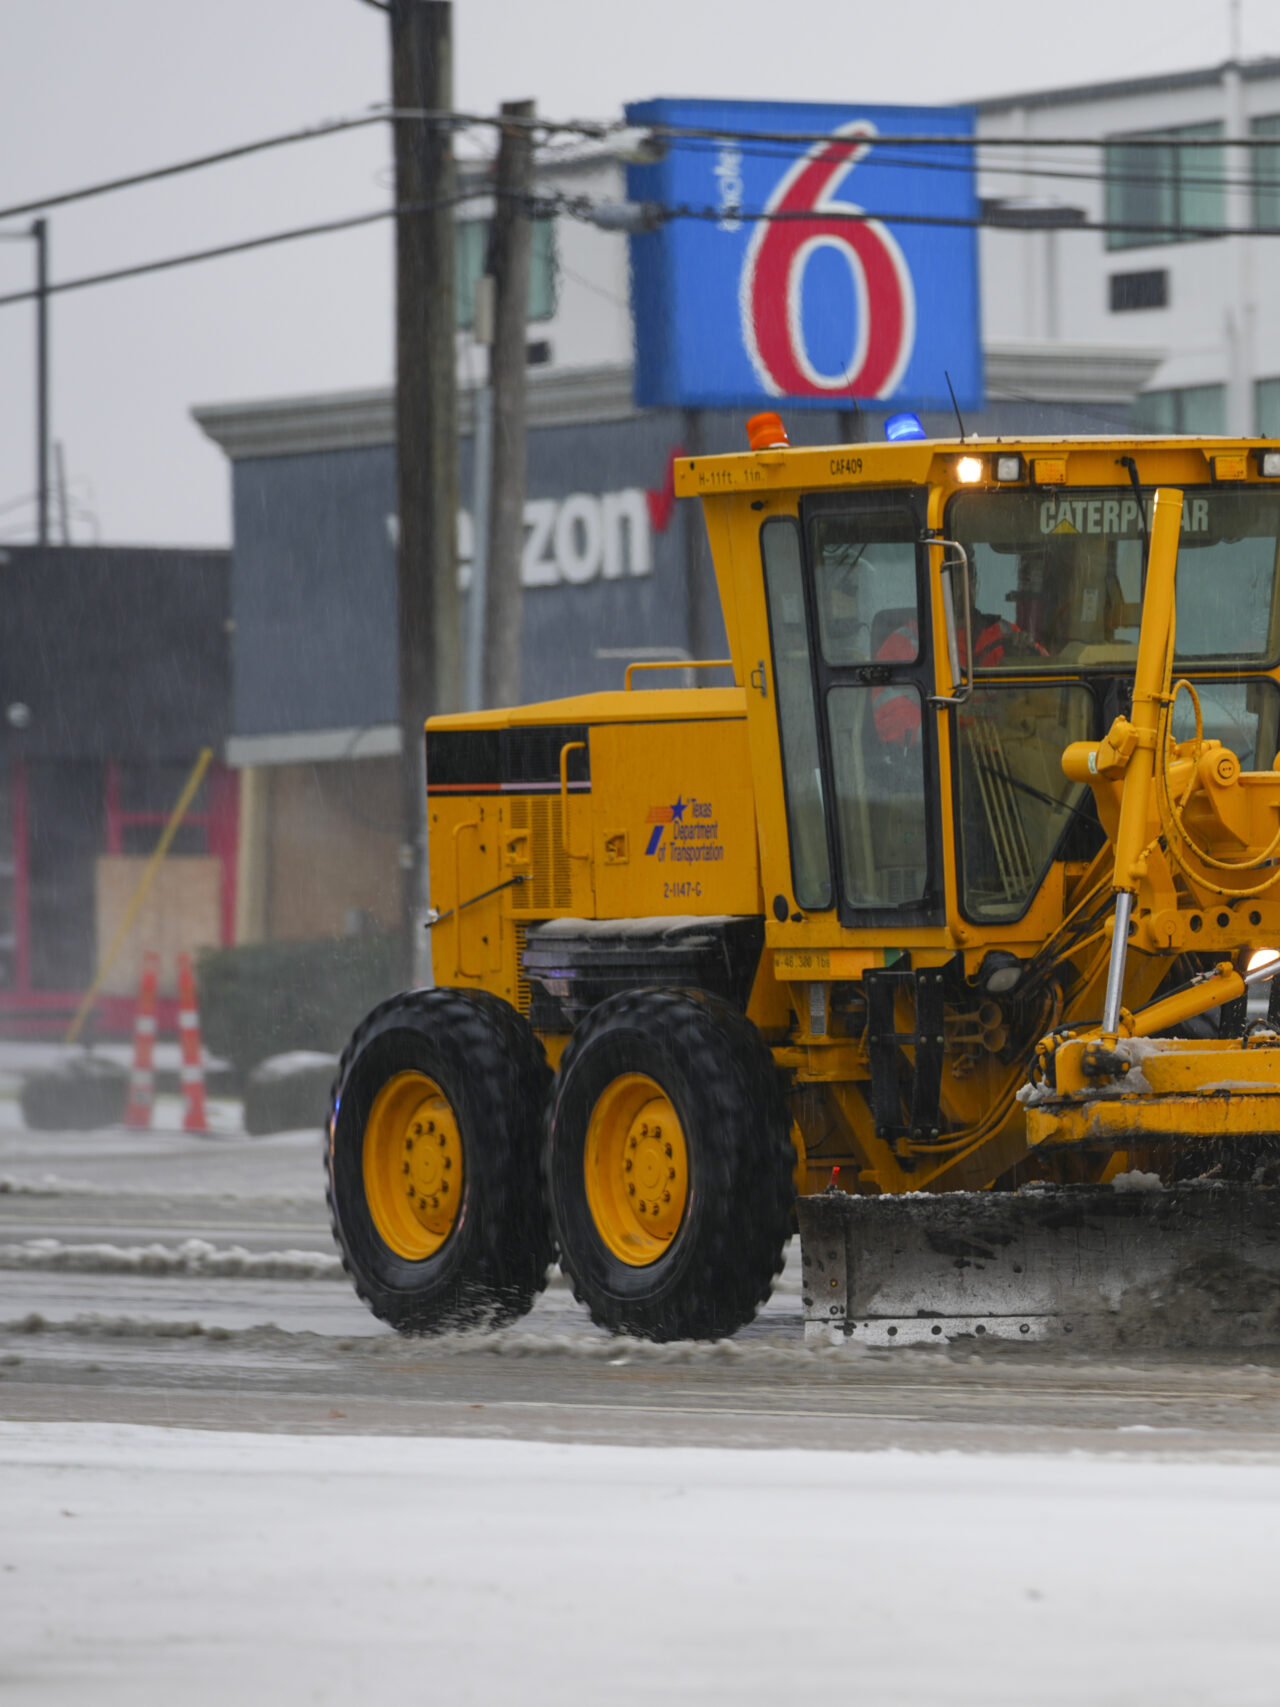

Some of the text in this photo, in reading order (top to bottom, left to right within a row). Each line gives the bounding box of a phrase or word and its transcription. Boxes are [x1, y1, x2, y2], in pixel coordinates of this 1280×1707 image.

[739, 119, 915, 400] 6
[829, 459, 863, 476] CAF409
[691, 798, 712, 818] Texas
[673, 821, 718, 841] Department
[658, 842, 724, 865] of Transportation
